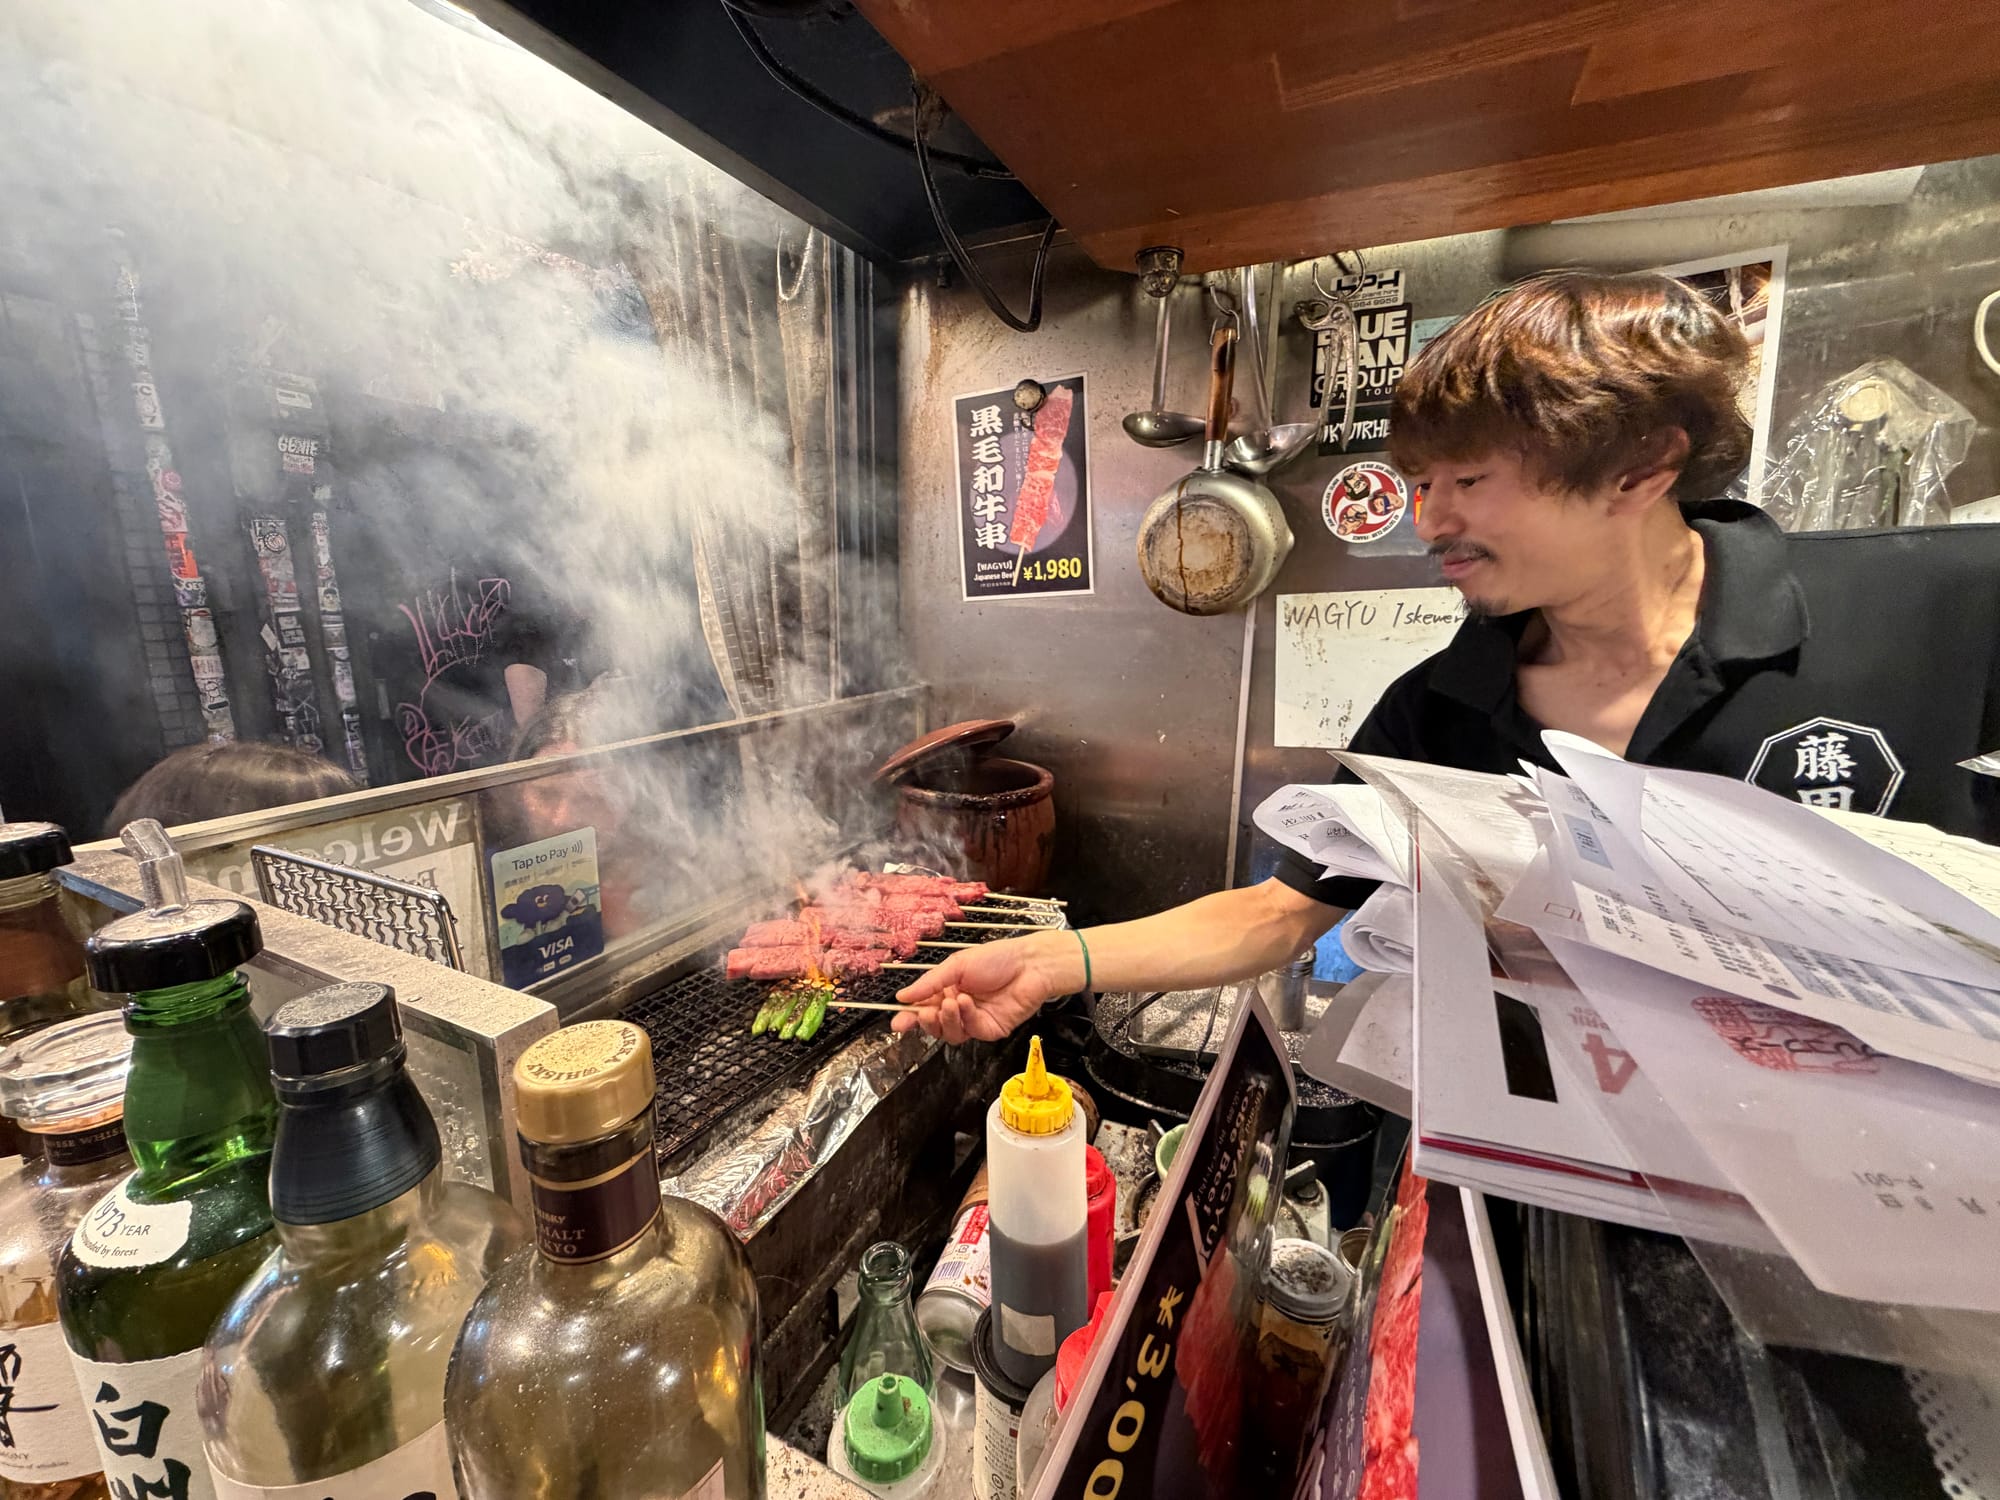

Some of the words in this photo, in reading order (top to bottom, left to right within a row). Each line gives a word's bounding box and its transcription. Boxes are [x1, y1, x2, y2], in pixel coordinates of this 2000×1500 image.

[970, 405, 1008, 550] 黒毛和牛串
[1023, 557, 1082, 581] ¥1,980
[1284, 600, 1377, 630] WAGYU
[512, 858, 534, 871] Tap
[535, 853, 548, 863] to
[549, 847, 569, 860] Pay
[538, 936, 574, 959] VISA
[604, 1026, 637, 1065] NIKKA
[527, 1063, 601, 1081] WHISKY
[119, 1224, 152, 1237] YEAR
[111, 1247, 139, 1257] forest
